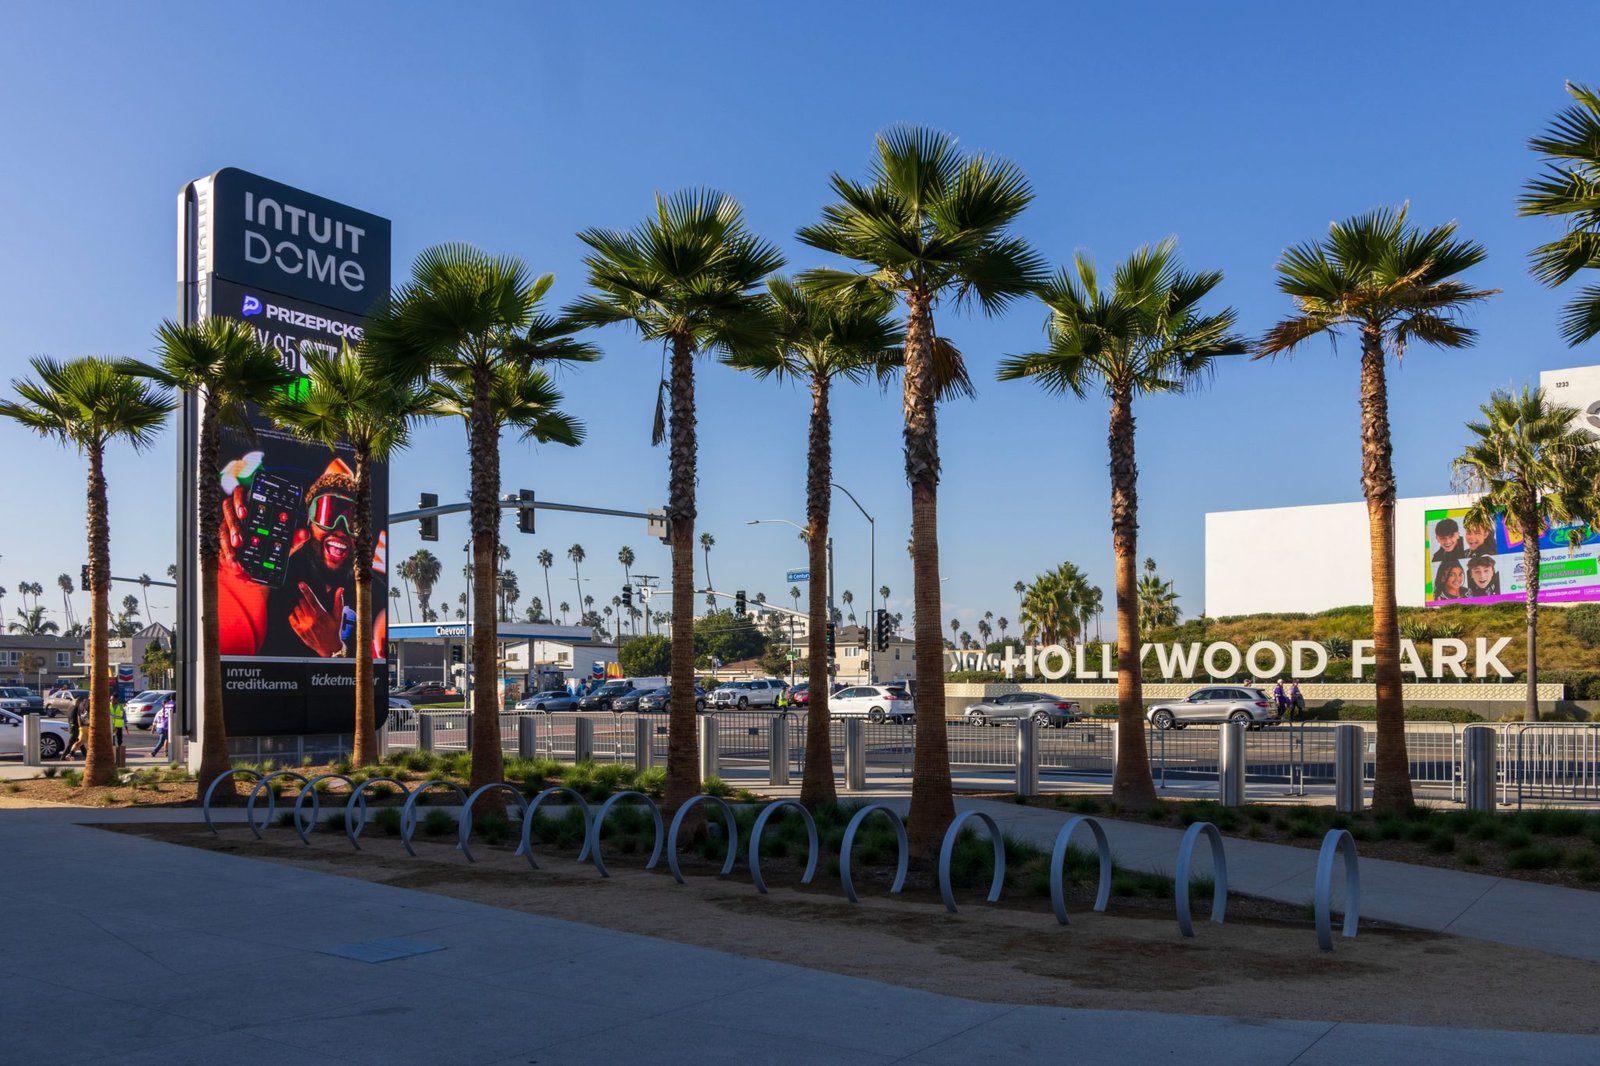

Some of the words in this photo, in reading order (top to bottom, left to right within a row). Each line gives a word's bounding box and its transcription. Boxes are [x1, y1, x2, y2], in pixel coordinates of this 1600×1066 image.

[245, 191, 366, 254] INTUIT
[266, 303, 365, 341] PRIZEPICKS
[435, 626, 466, 636] Chevron
[226, 668, 262, 677] INTUIT
[226, 678, 298, 690] creditkarma
[311, 673, 380, 686] ticketmar
